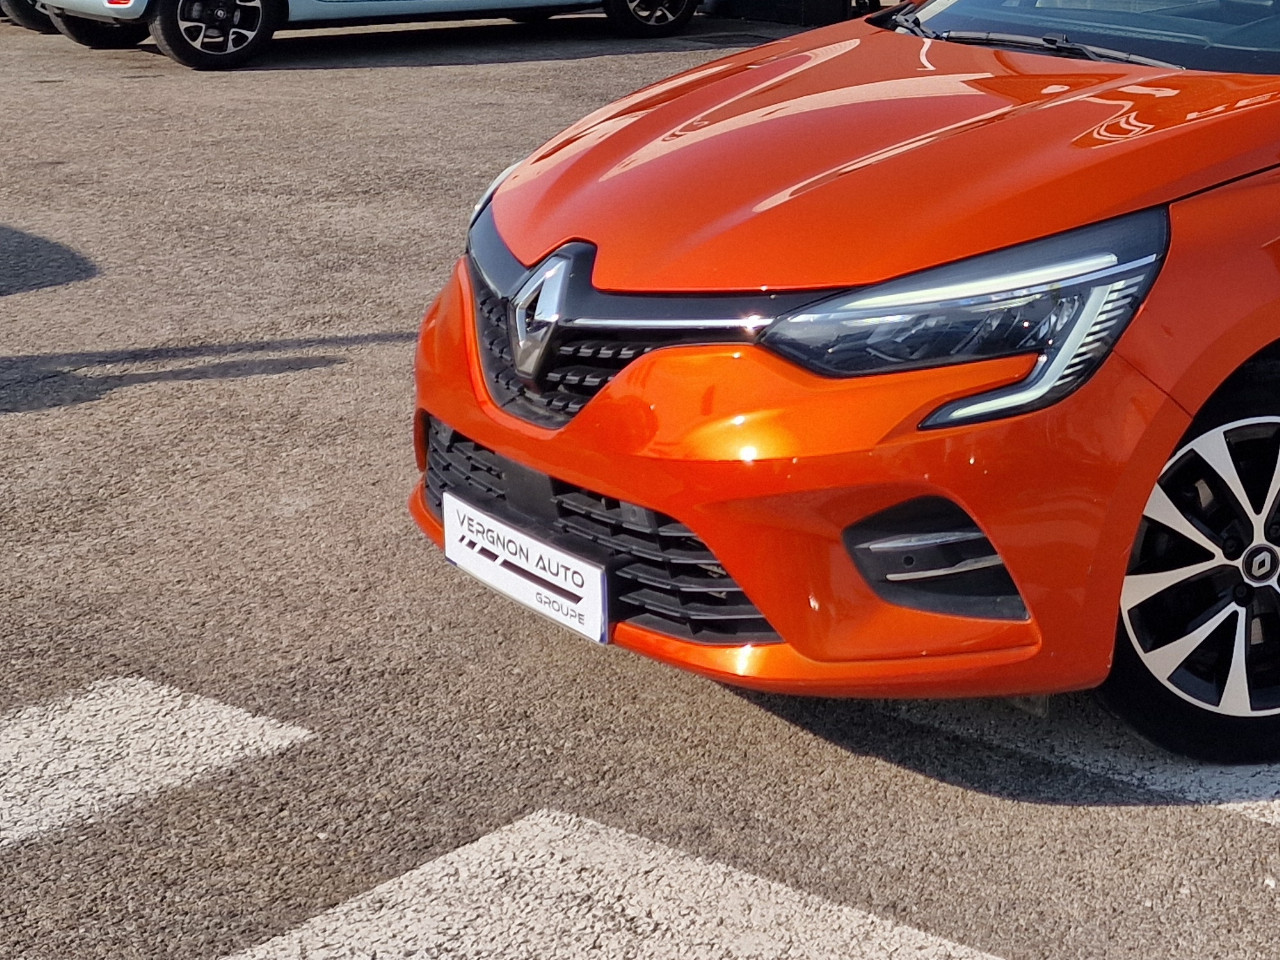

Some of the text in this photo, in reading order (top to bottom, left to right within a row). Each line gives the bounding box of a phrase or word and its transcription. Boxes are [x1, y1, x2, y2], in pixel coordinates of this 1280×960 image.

[457, 510, 585, 589] VERGNON AUTO
[535, 592, 585, 626] GROUPE
